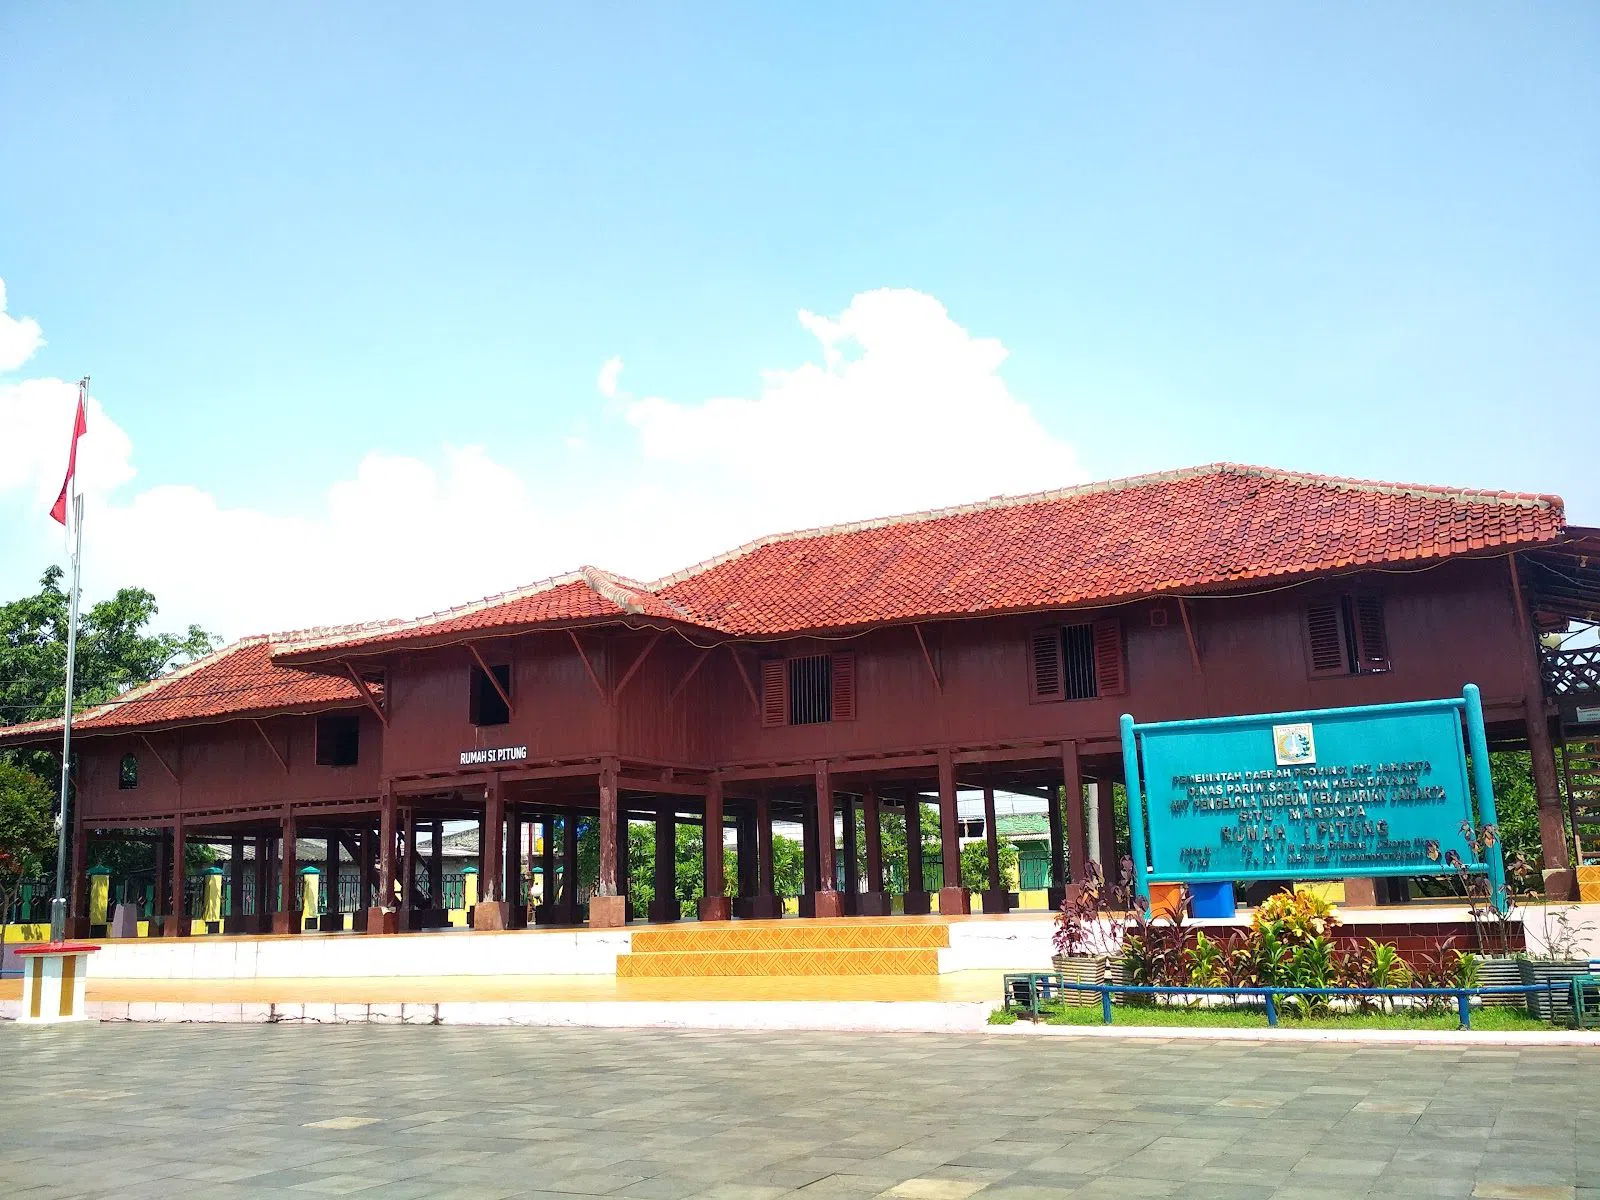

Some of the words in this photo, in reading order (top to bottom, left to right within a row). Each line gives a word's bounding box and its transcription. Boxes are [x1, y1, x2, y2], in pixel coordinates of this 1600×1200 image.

[460, 750, 487, 764] RUMAH
[487, 749, 497, 762] SI
[497, 746, 527, 761] PITUNG
[1246, 768, 1291, 780] DAERAH
[1377, 760, 1432, 773] JAKARTA
[1226, 781, 1300, 795] PARIWSATA
[1303, 779, 1329, 791] DAN
[1193, 795, 1258, 810] PENGELOLA
[1261, 792, 1308, 807] MUSEUM
[1239, 808, 1283, 822] SITU
[1221, 824, 1287, 842] RUMAH
